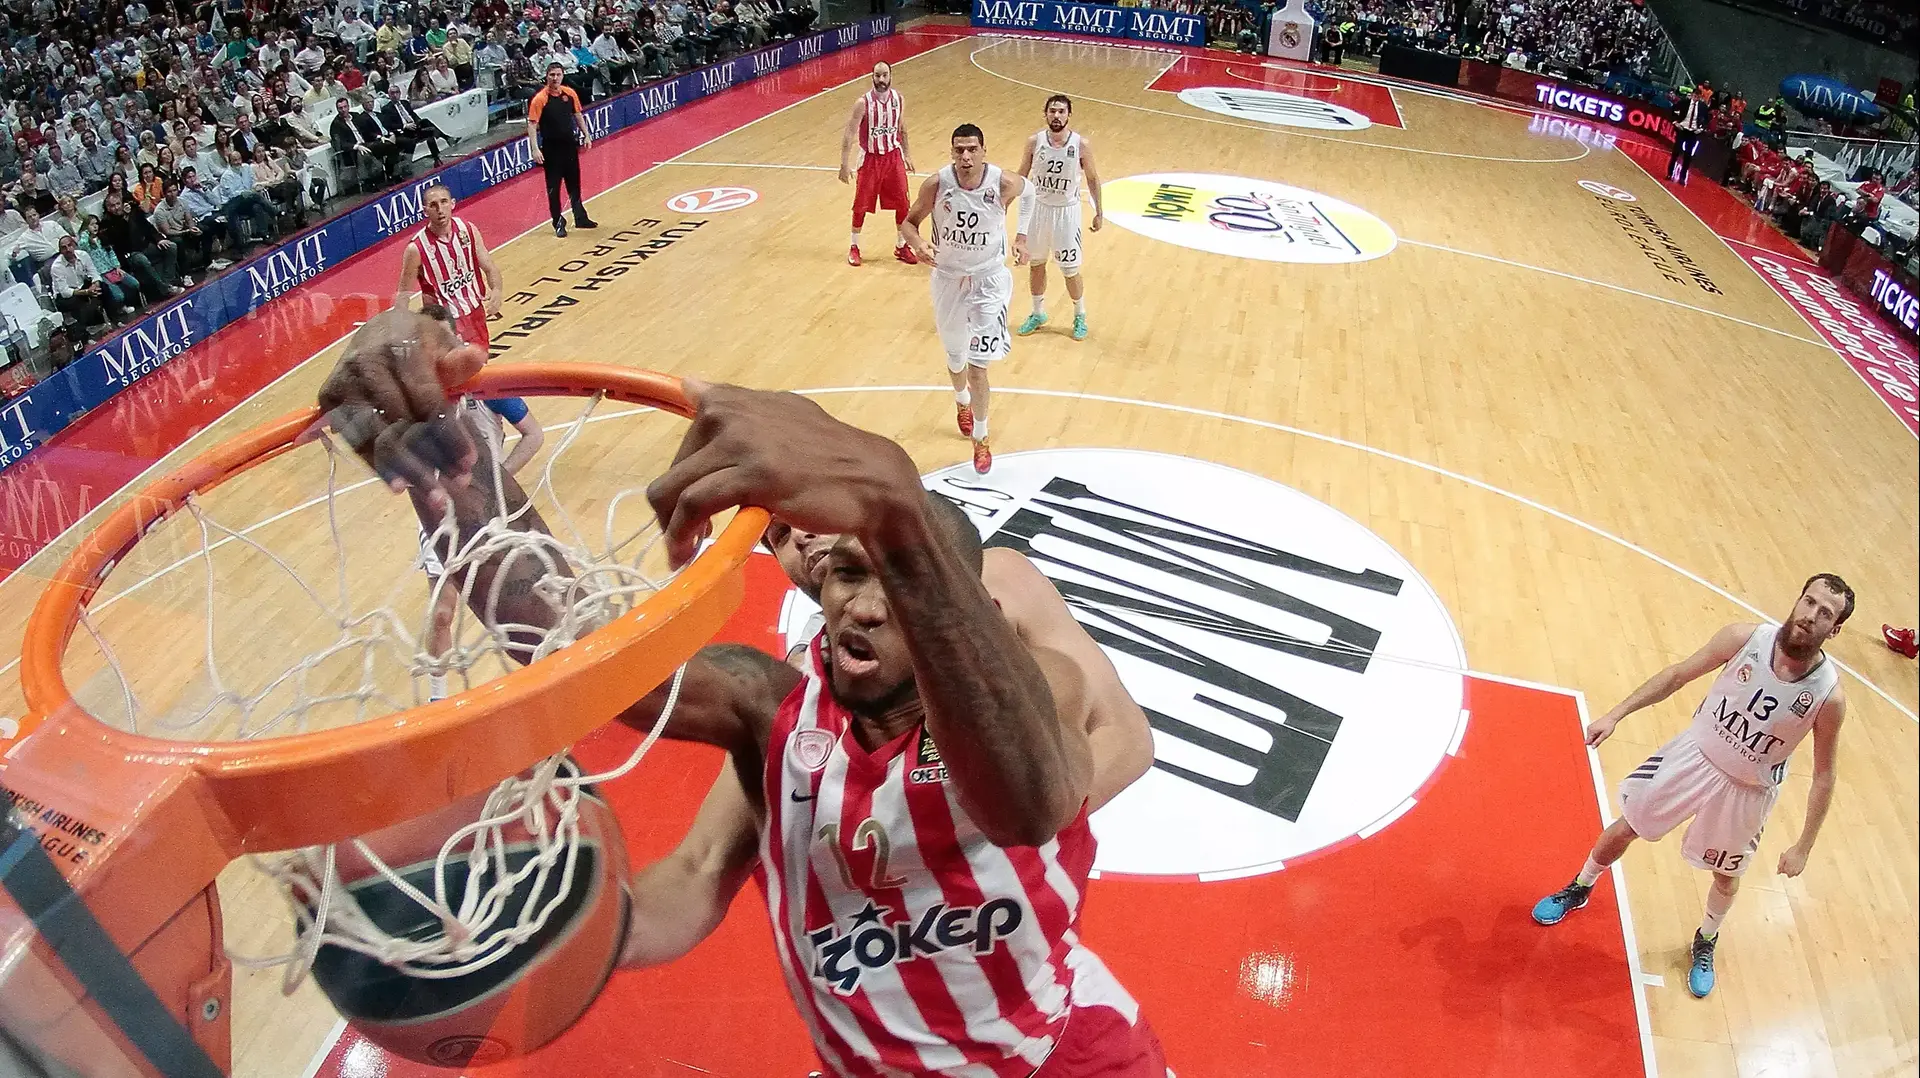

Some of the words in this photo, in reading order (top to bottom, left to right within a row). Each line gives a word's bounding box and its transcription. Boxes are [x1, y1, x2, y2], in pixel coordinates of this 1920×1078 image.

[978, 0, 1044, 22] MMT
[985, 18, 1034, 27] SEGUROS
[1053, 5, 1122, 29] MMT
[1131, 12, 1201, 38] MMT
[838, 24, 860, 45] MMT
[1061, 22, 1111, 34] SEGUROS
[1138, 31, 1190, 43] SEGUROS
[753, 47, 783, 73] MMT
[798, 34, 824, 58] MMT
[702, 61, 735, 91] MMT
[639, 81, 680, 114] MMT
[646, 101, 676, 118] SEGUROS
[1536, 84, 1624, 122] TICKETS
[1628, 109, 1661, 132] ON
[1796, 80, 1865, 115] MMT
[480, 137, 534, 181] MMT
[490, 161, 533, 186] SEGUROS
[1047, 160, 1064, 174] 23
[1142, 183, 1197, 222] LIMÓN
[387, 208, 429, 236] SEGUR
[943, 226, 990, 246] MMT
[956, 211, 979, 229] 50
[571, 219, 709, 291] TURKISH
[1061, 249, 1077, 262] 23
[1594, 195, 1687, 286] EUROLEAGUE
[246, 229, 328, 299] MMT
[486, 218, 662, 322] EUROLE
[1661, 241, 1724, 296] AIRLINES
[264, 263, 325, 301] SEGUROS
[1791, 267, 1898, 349] Palacio
[1870, 269, 1919, 336] TICKE
[96, 299, 195, 386] MMT
[488, 294, 580, 360] AIRLI
[1751, 256, 1890, 368] Comunidad
[1866, 366, 1916, 402] de
[980, 336, 999, 353] 50
[121, 337, 192, 387] SEGUROS
[1746, 688, 1780, 722] 13
[1711, 695, 1785, 755] MMT
[40, 808, 106, 845] AIRLINES
[819, 816, 908, 890] 12
[1716, 850, 1744, 871] 13
